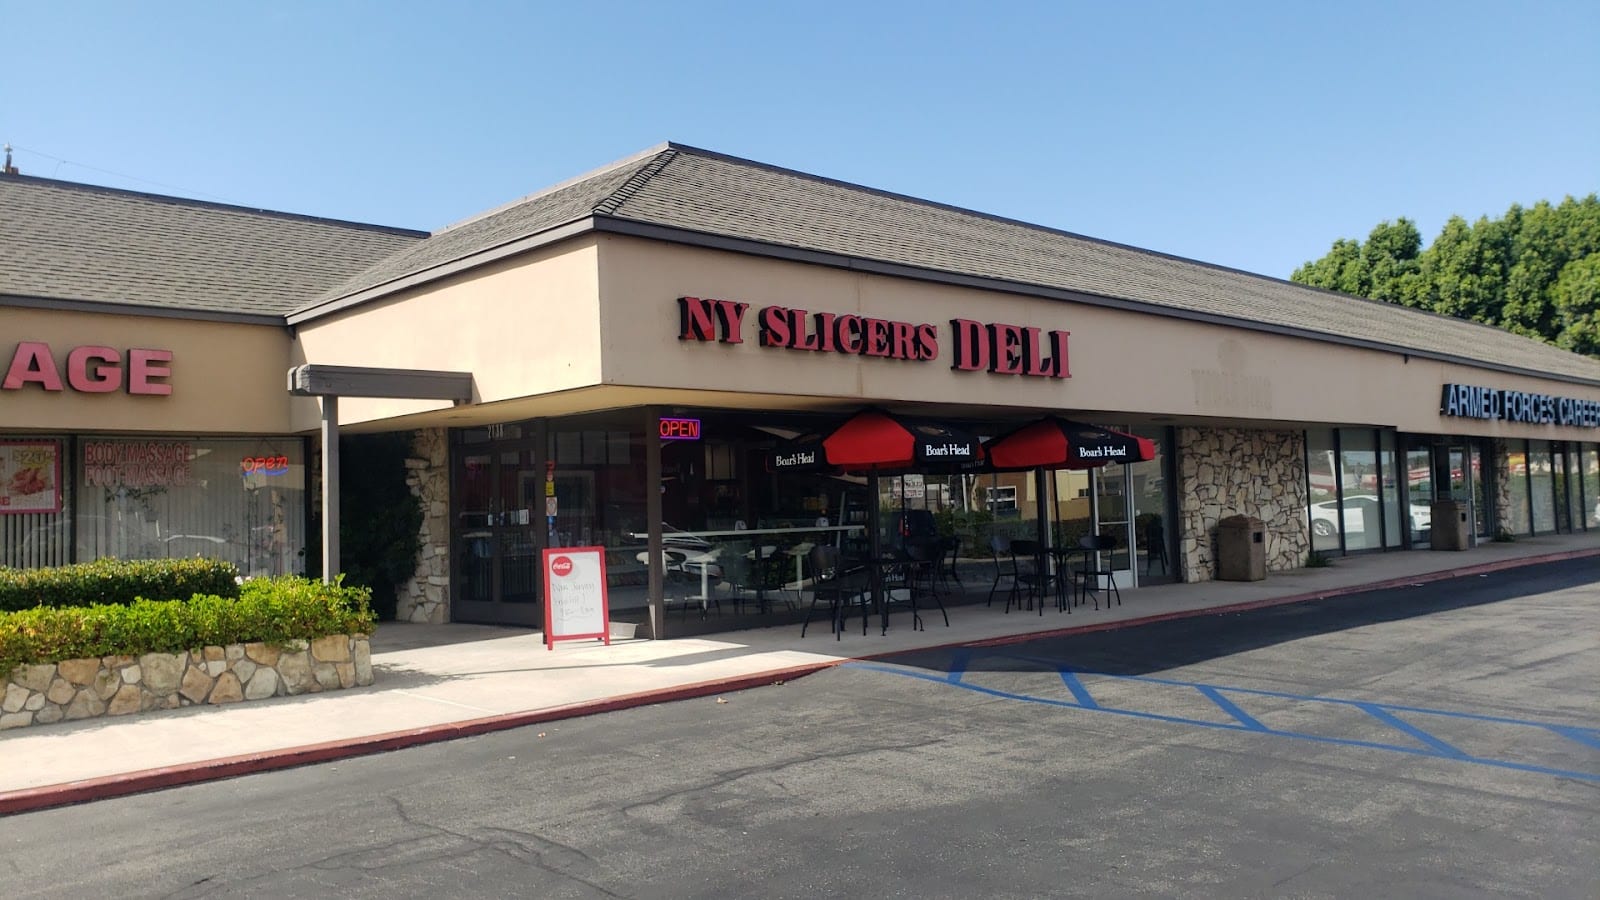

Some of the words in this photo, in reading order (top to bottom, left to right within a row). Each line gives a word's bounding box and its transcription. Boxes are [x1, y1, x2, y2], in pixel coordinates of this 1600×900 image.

[678, 297, 749, 343] NY
[759, 305, 937, 361] SLICERS
[949, 318, 1072, 379] DELI
[2, 341, 173, 396] AGE
[1445, 384, 1500, 418] ARMED
[1503, 390, 1556, 424] FORCES
[660, 420, 698, 437] OPEN
[85, 442, 122, 464] BODY
[125, 442, 191, 464] MASSAGE
[776, 454, 797, 466] Boar's
[797, 452, 815, 465] Head
[926, 444, 948, 456] Boar's
[949, 444, 970, 456] Head
[1079, 447, 1103, 458] Boar's
[1104, 445, 1126, 456] Head
[85, 465, 122, 487] FOOT
[125, 464, 191, 487] MASSAGE
